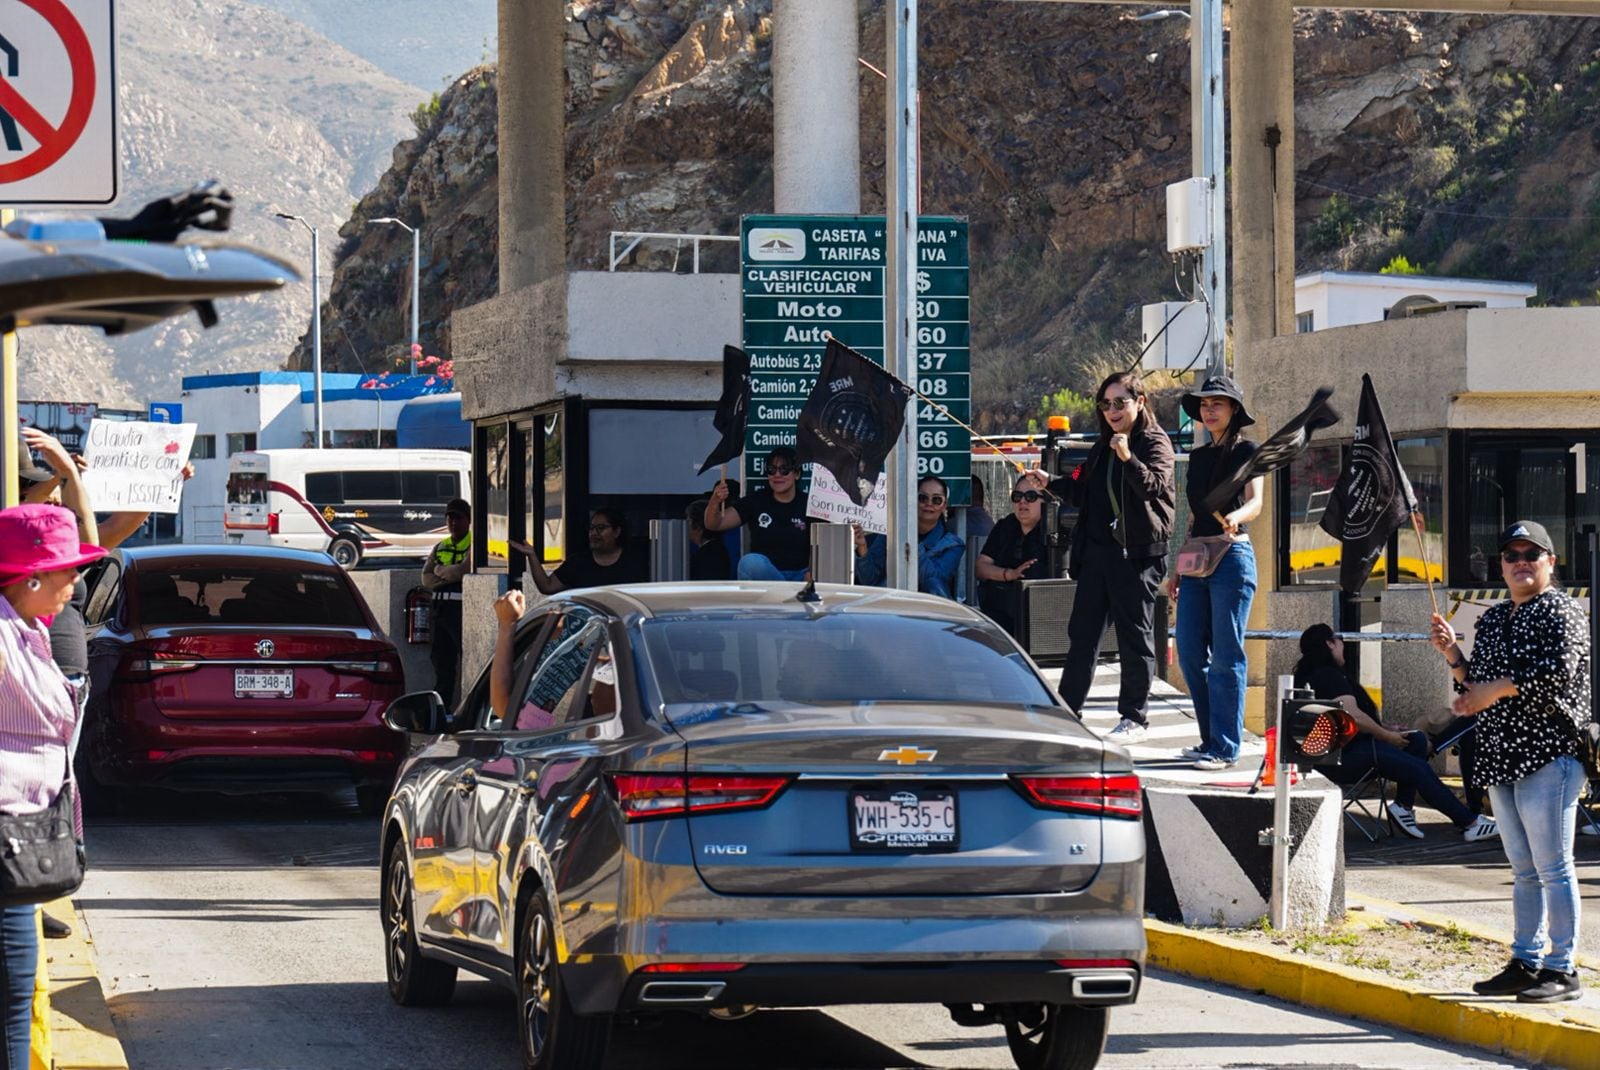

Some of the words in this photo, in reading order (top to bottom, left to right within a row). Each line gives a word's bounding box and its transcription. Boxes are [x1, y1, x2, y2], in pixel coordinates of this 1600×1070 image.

[812, 229, 867, 242] CASETA
[819, 248, 880, 260] TARIFAS
[921, 248, 947, 261] IVA
[748, 270, 872, 282] CLASIFICACION
[917, 271, 931, 293] $
[763, 282, 857, 293] VEHICULAR
[777, 301, 842, 318] Moto
[783, 325, 833, 342] Auto
[750, 353, 800, 369] Autobús
[751, 378, 797, 394] Camión
[91, 423, 143, 448] Claudia
[753, 430, 797, 446] Camión
[92, 451, 150, 470] mentiste
[155, 456, 180, 471] con
[1569, 442, 1586, 494] 1
[811, 494, 835, 512] Son
[237, 676, 291, 689] BRM-348-A
[856, 805, 954, 829] VWH-535-C
[886, 833, 954, 842] CHEVROLET
[703, 844, 748, 855] AVEO
